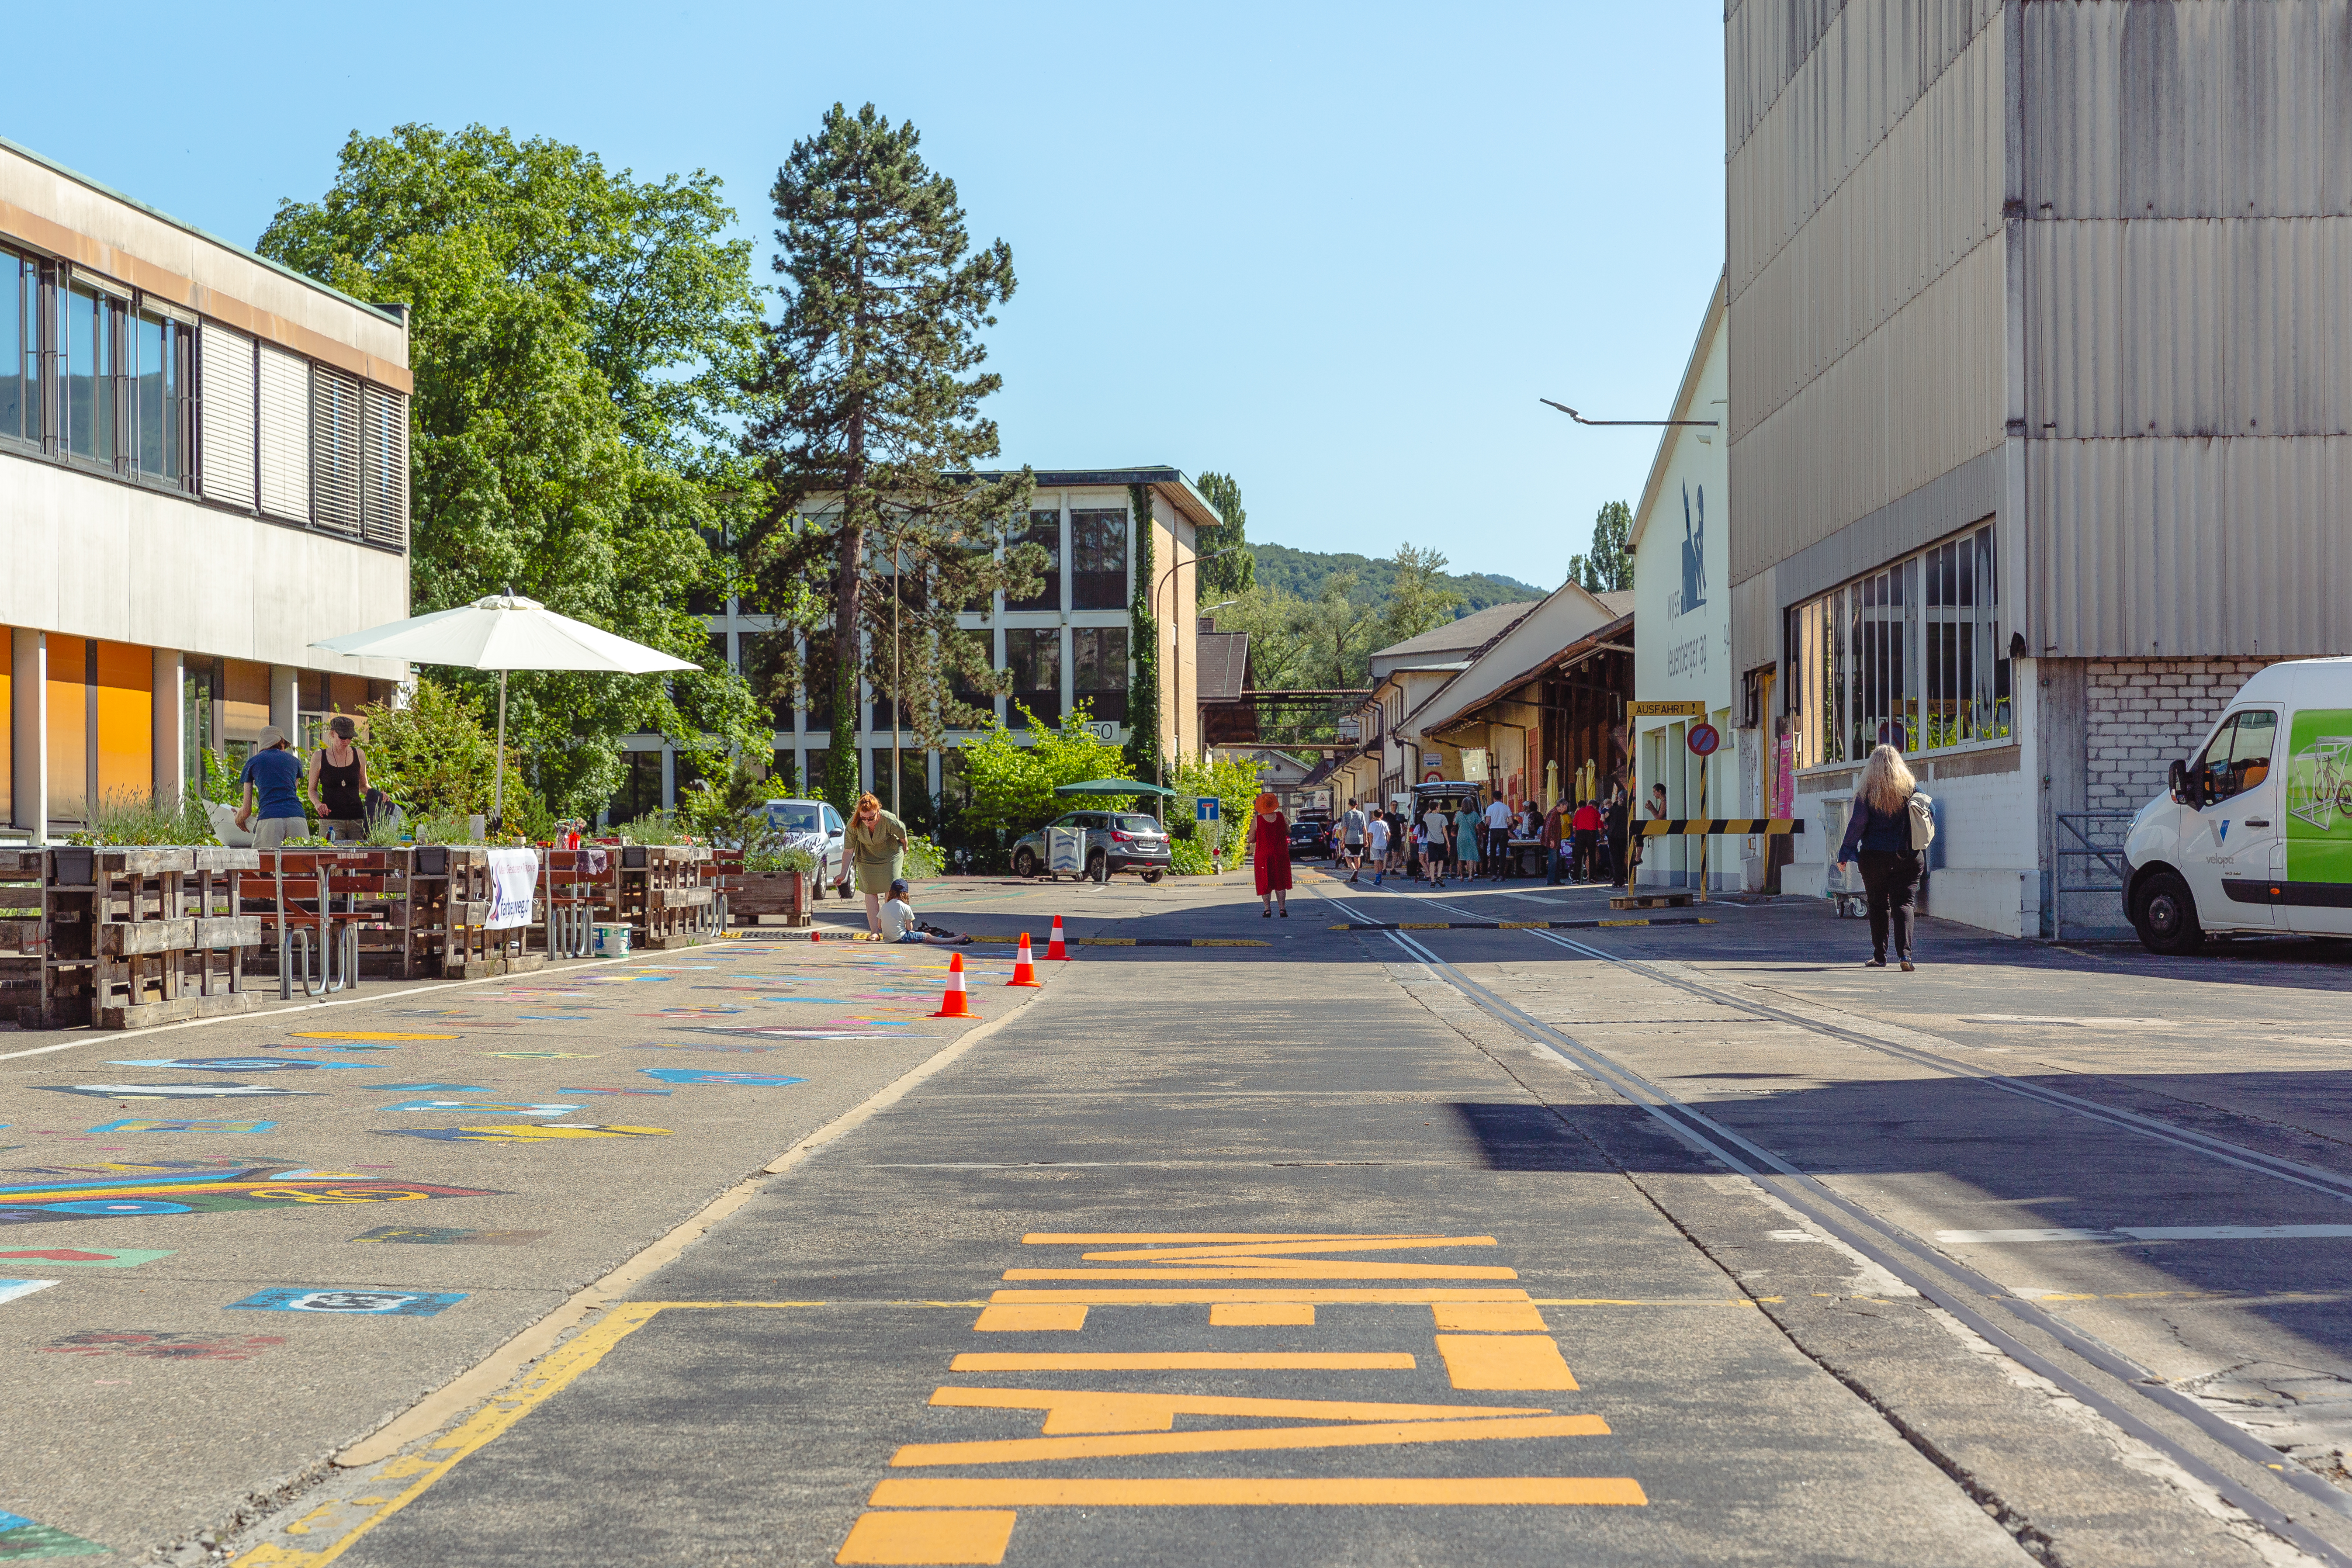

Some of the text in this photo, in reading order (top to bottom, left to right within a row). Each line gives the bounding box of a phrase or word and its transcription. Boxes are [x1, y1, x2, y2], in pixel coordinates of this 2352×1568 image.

[1667, 589, 1680, 630] wyss
[1667, 634, 1707, 679] leuenberger ag
[1636, 704, 1685, 714] AUSFAHRT
[1089, 723, 1112, 739] 50
[2206, 852, 2234, 868] velopa
